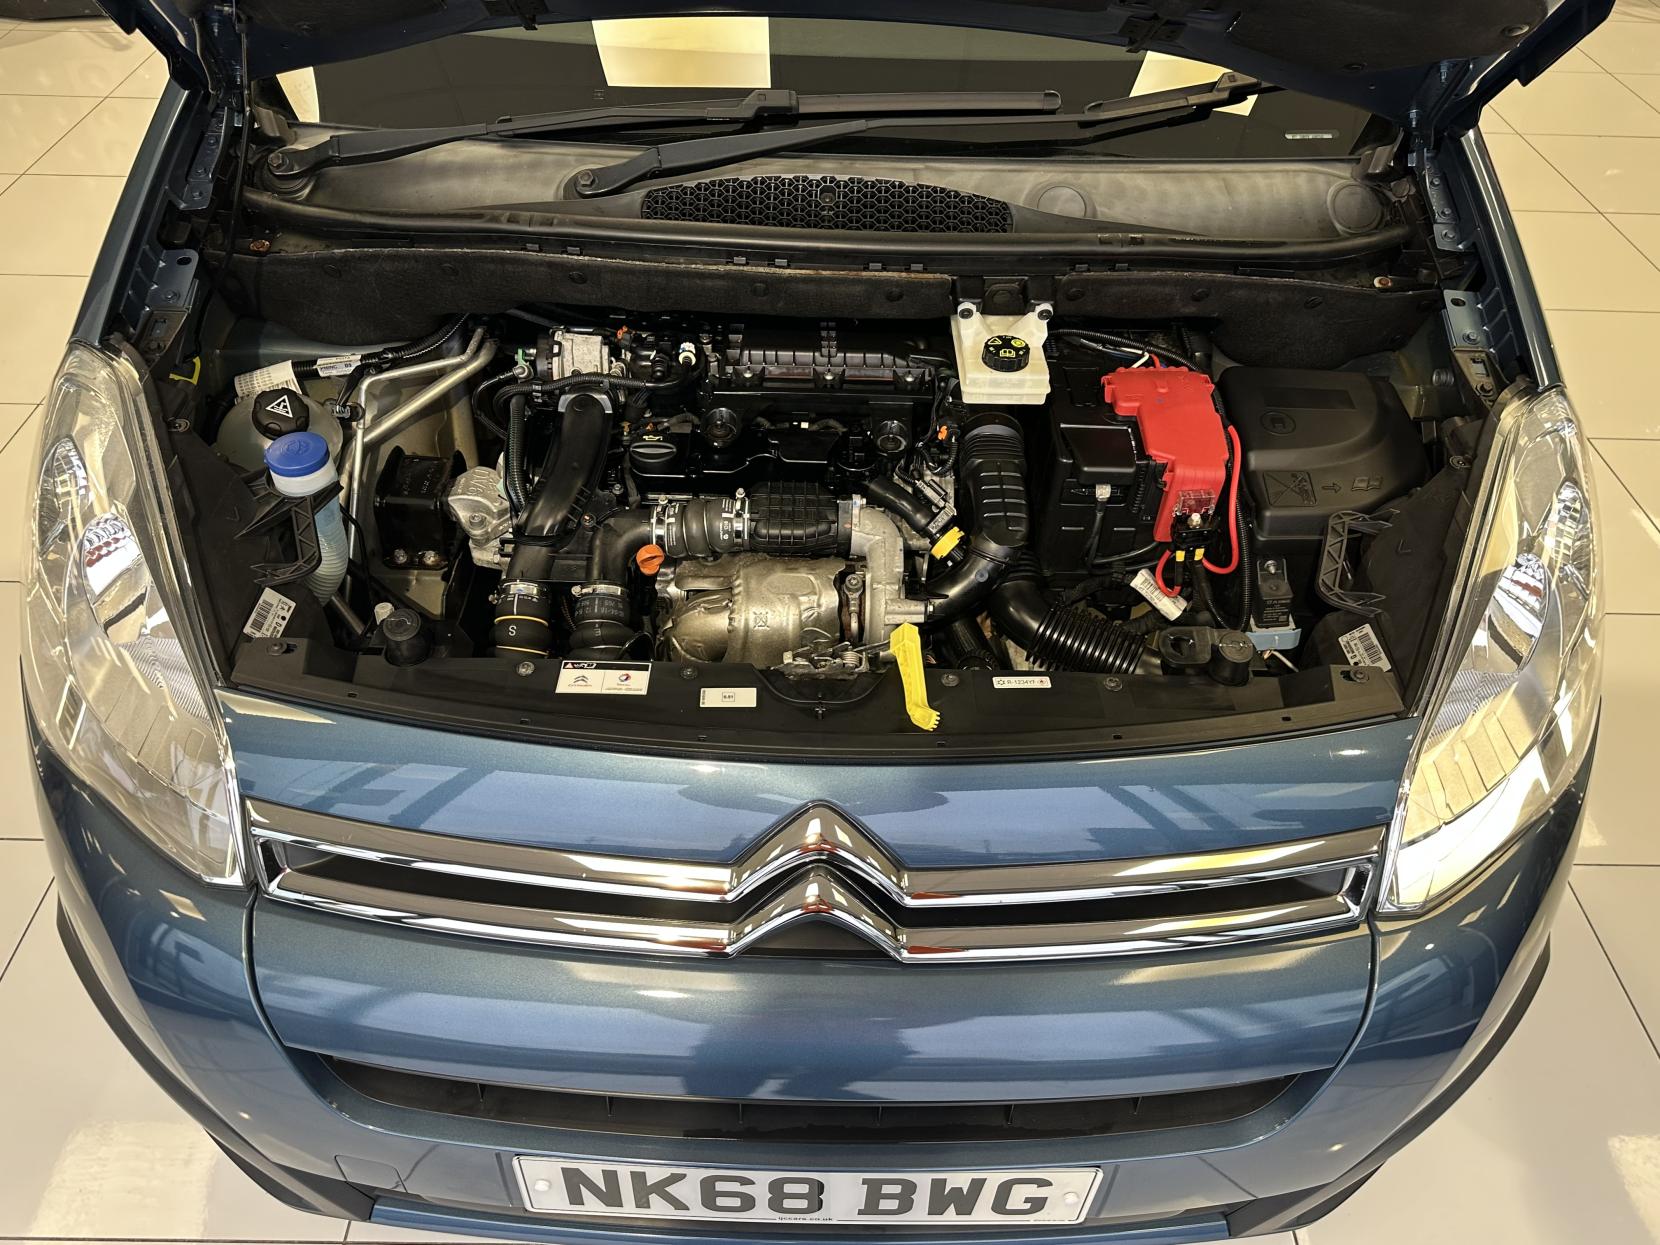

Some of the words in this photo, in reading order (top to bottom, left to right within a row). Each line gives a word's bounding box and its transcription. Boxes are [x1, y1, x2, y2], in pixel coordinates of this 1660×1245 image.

[508, 625, 517, 637] S
[560, 1166, 825, 1215] NK68
[857, 1177, 1054, 1216] BWG
